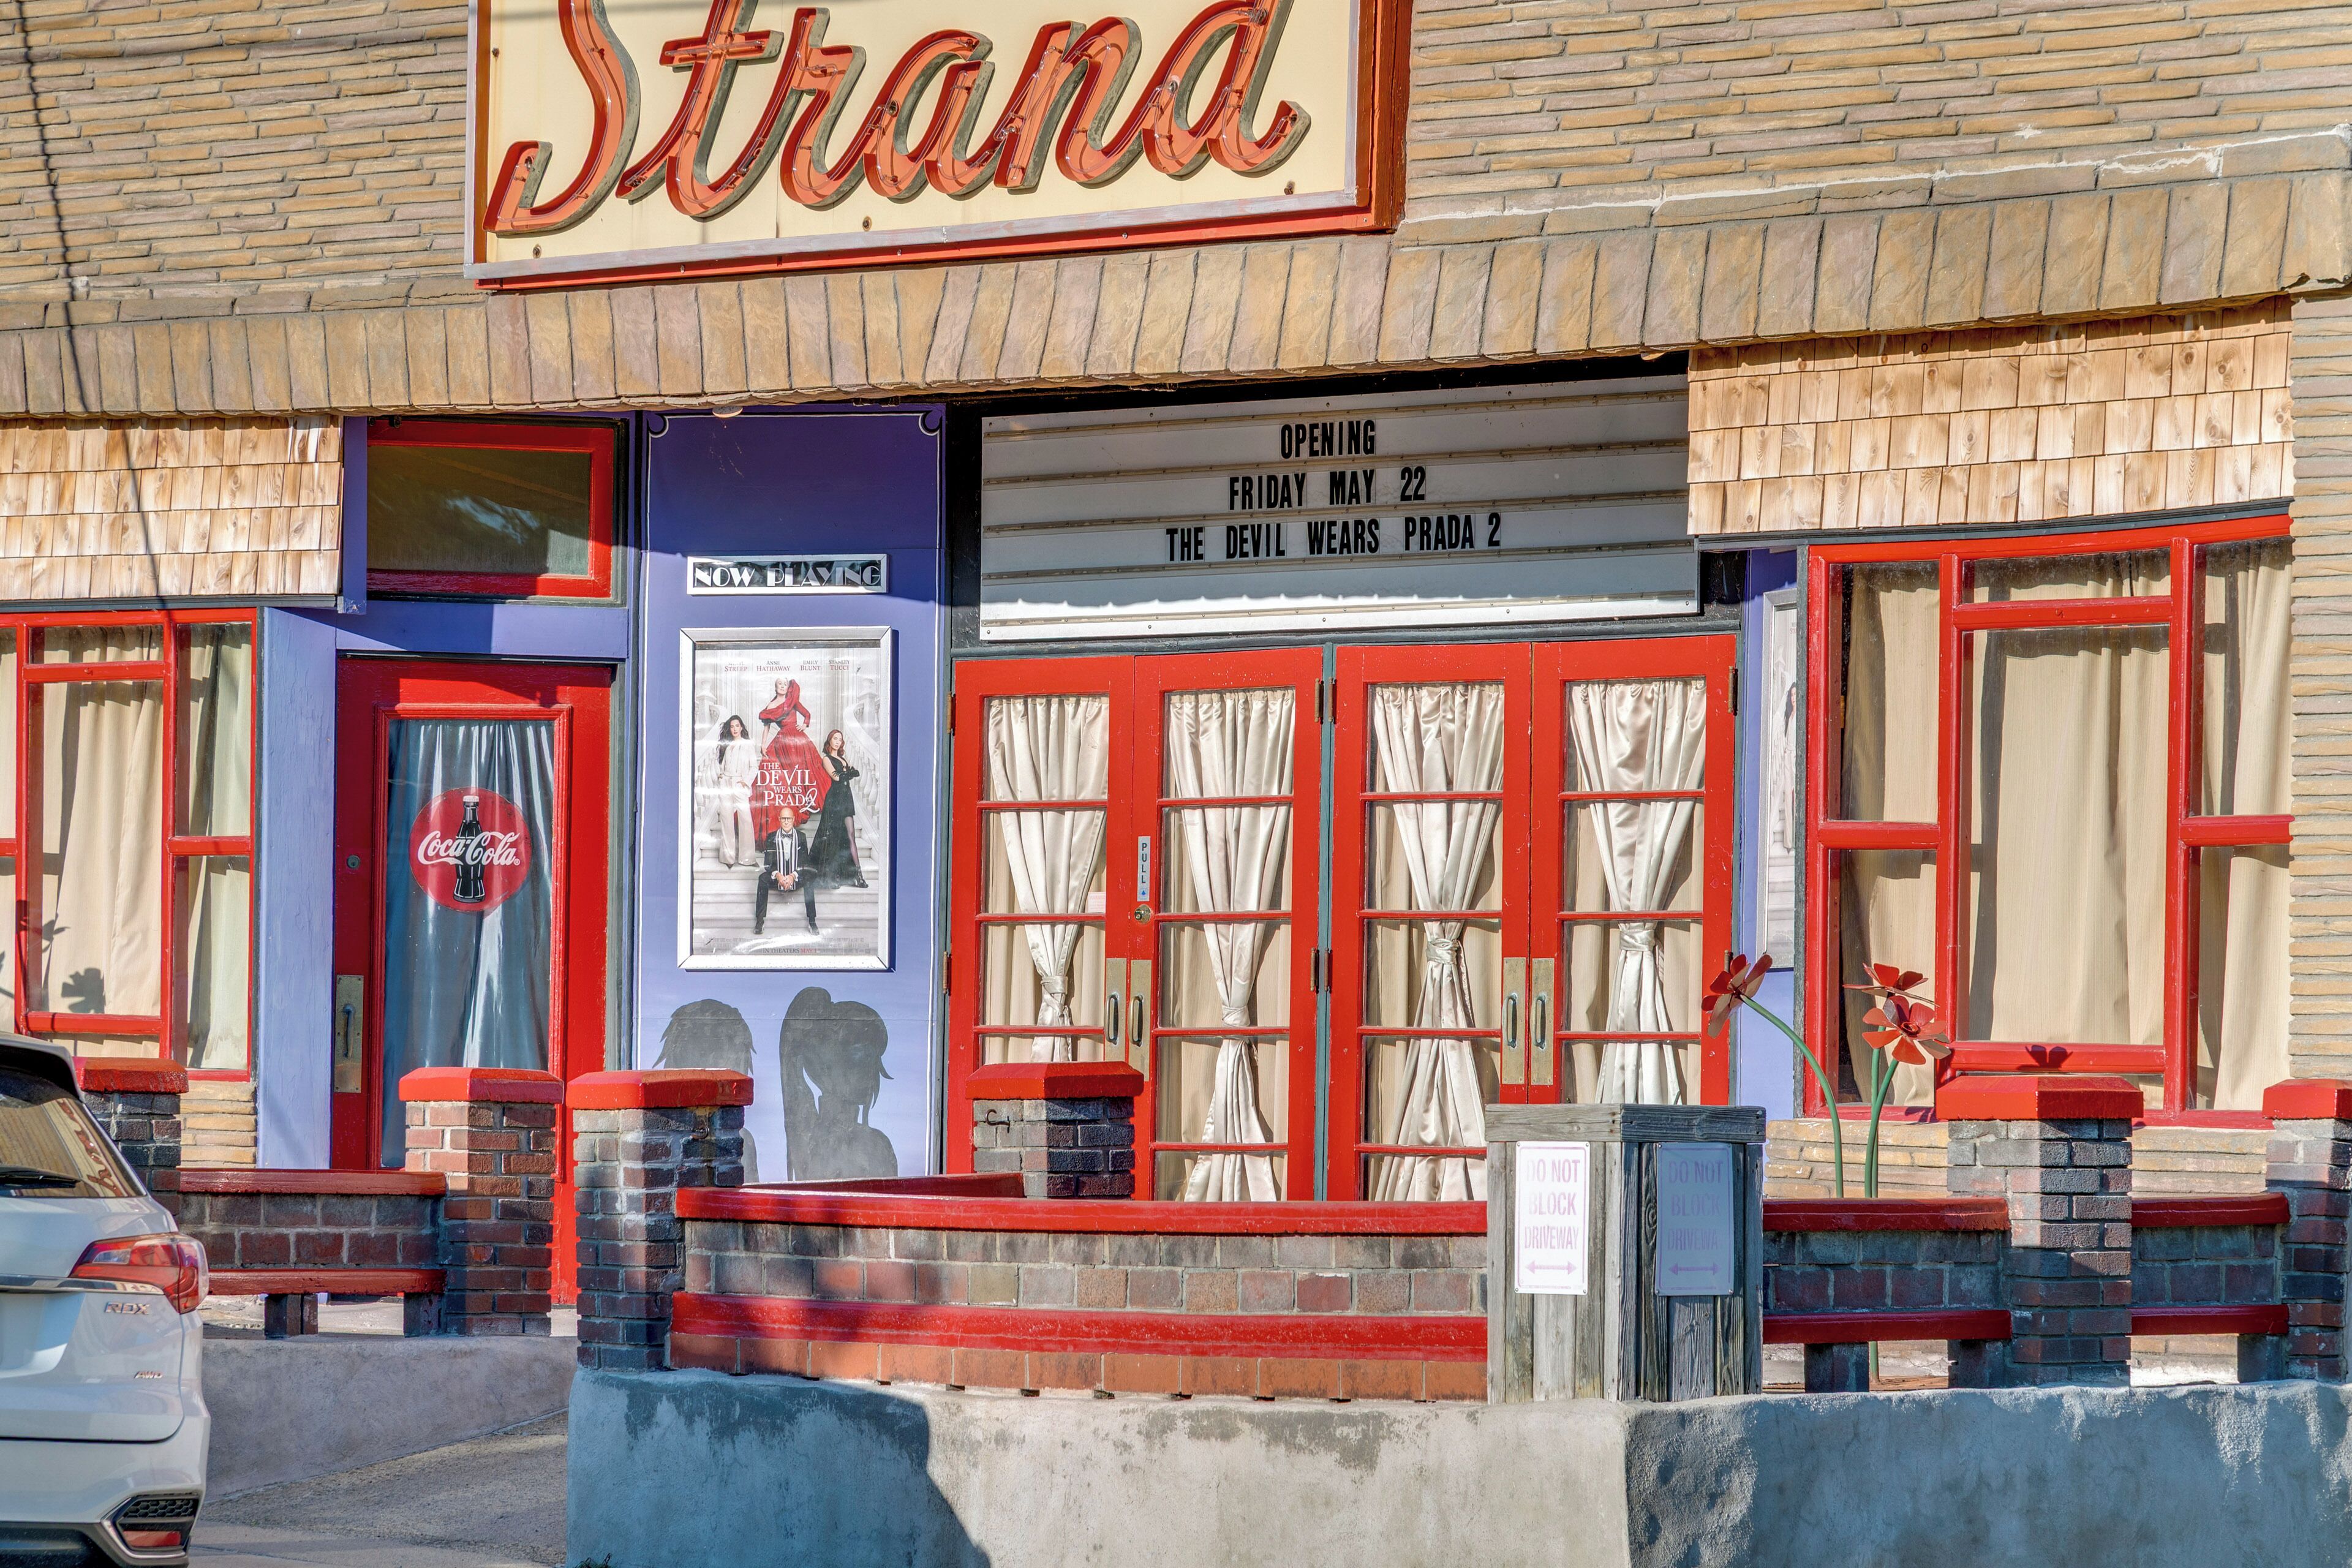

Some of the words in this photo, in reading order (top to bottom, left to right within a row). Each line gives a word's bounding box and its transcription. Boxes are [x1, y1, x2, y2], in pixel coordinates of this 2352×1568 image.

[483, 0, 1310, 234] Strand
[1280, 420, 1375, 459] OPENING
[1229, 472, 1306, 510] FRIDAY
[1329, 469, 1375, 505] MAY
[1400, 466, 1426, 501] 22
[1166, 527, 1204, 562] THE
[1226, 523, 1285, 559] DEVIL
[1307, 519, 1379, 555] WEARS
[1404, 514, 1474, 551] PRADA
[1488, 512, 1501, 547] 2
[695, 567, 755, 587] NOW
[767, 565, 881, 587] PLAYING
[755, 764, 816, 786] DEVIL
[763, 790, 816, 806] PRADA
[799, 788, 820, 813] 2
[1526, 1159, 1546, 1183] DO
[1551, 1158, 1580, 1183] NOT
[1668, 1160, 1689, 1183] DO
[1694, 1160, 1724, 1183] NOT
[1528, 1191, 1577, 1216] BLOCK
[1671, 1193, 1721, 1216] BLOCK
[1524, 1226, 1579, 1250] DRIVEWAY
[104, 1302, 150, 1315] RDX
